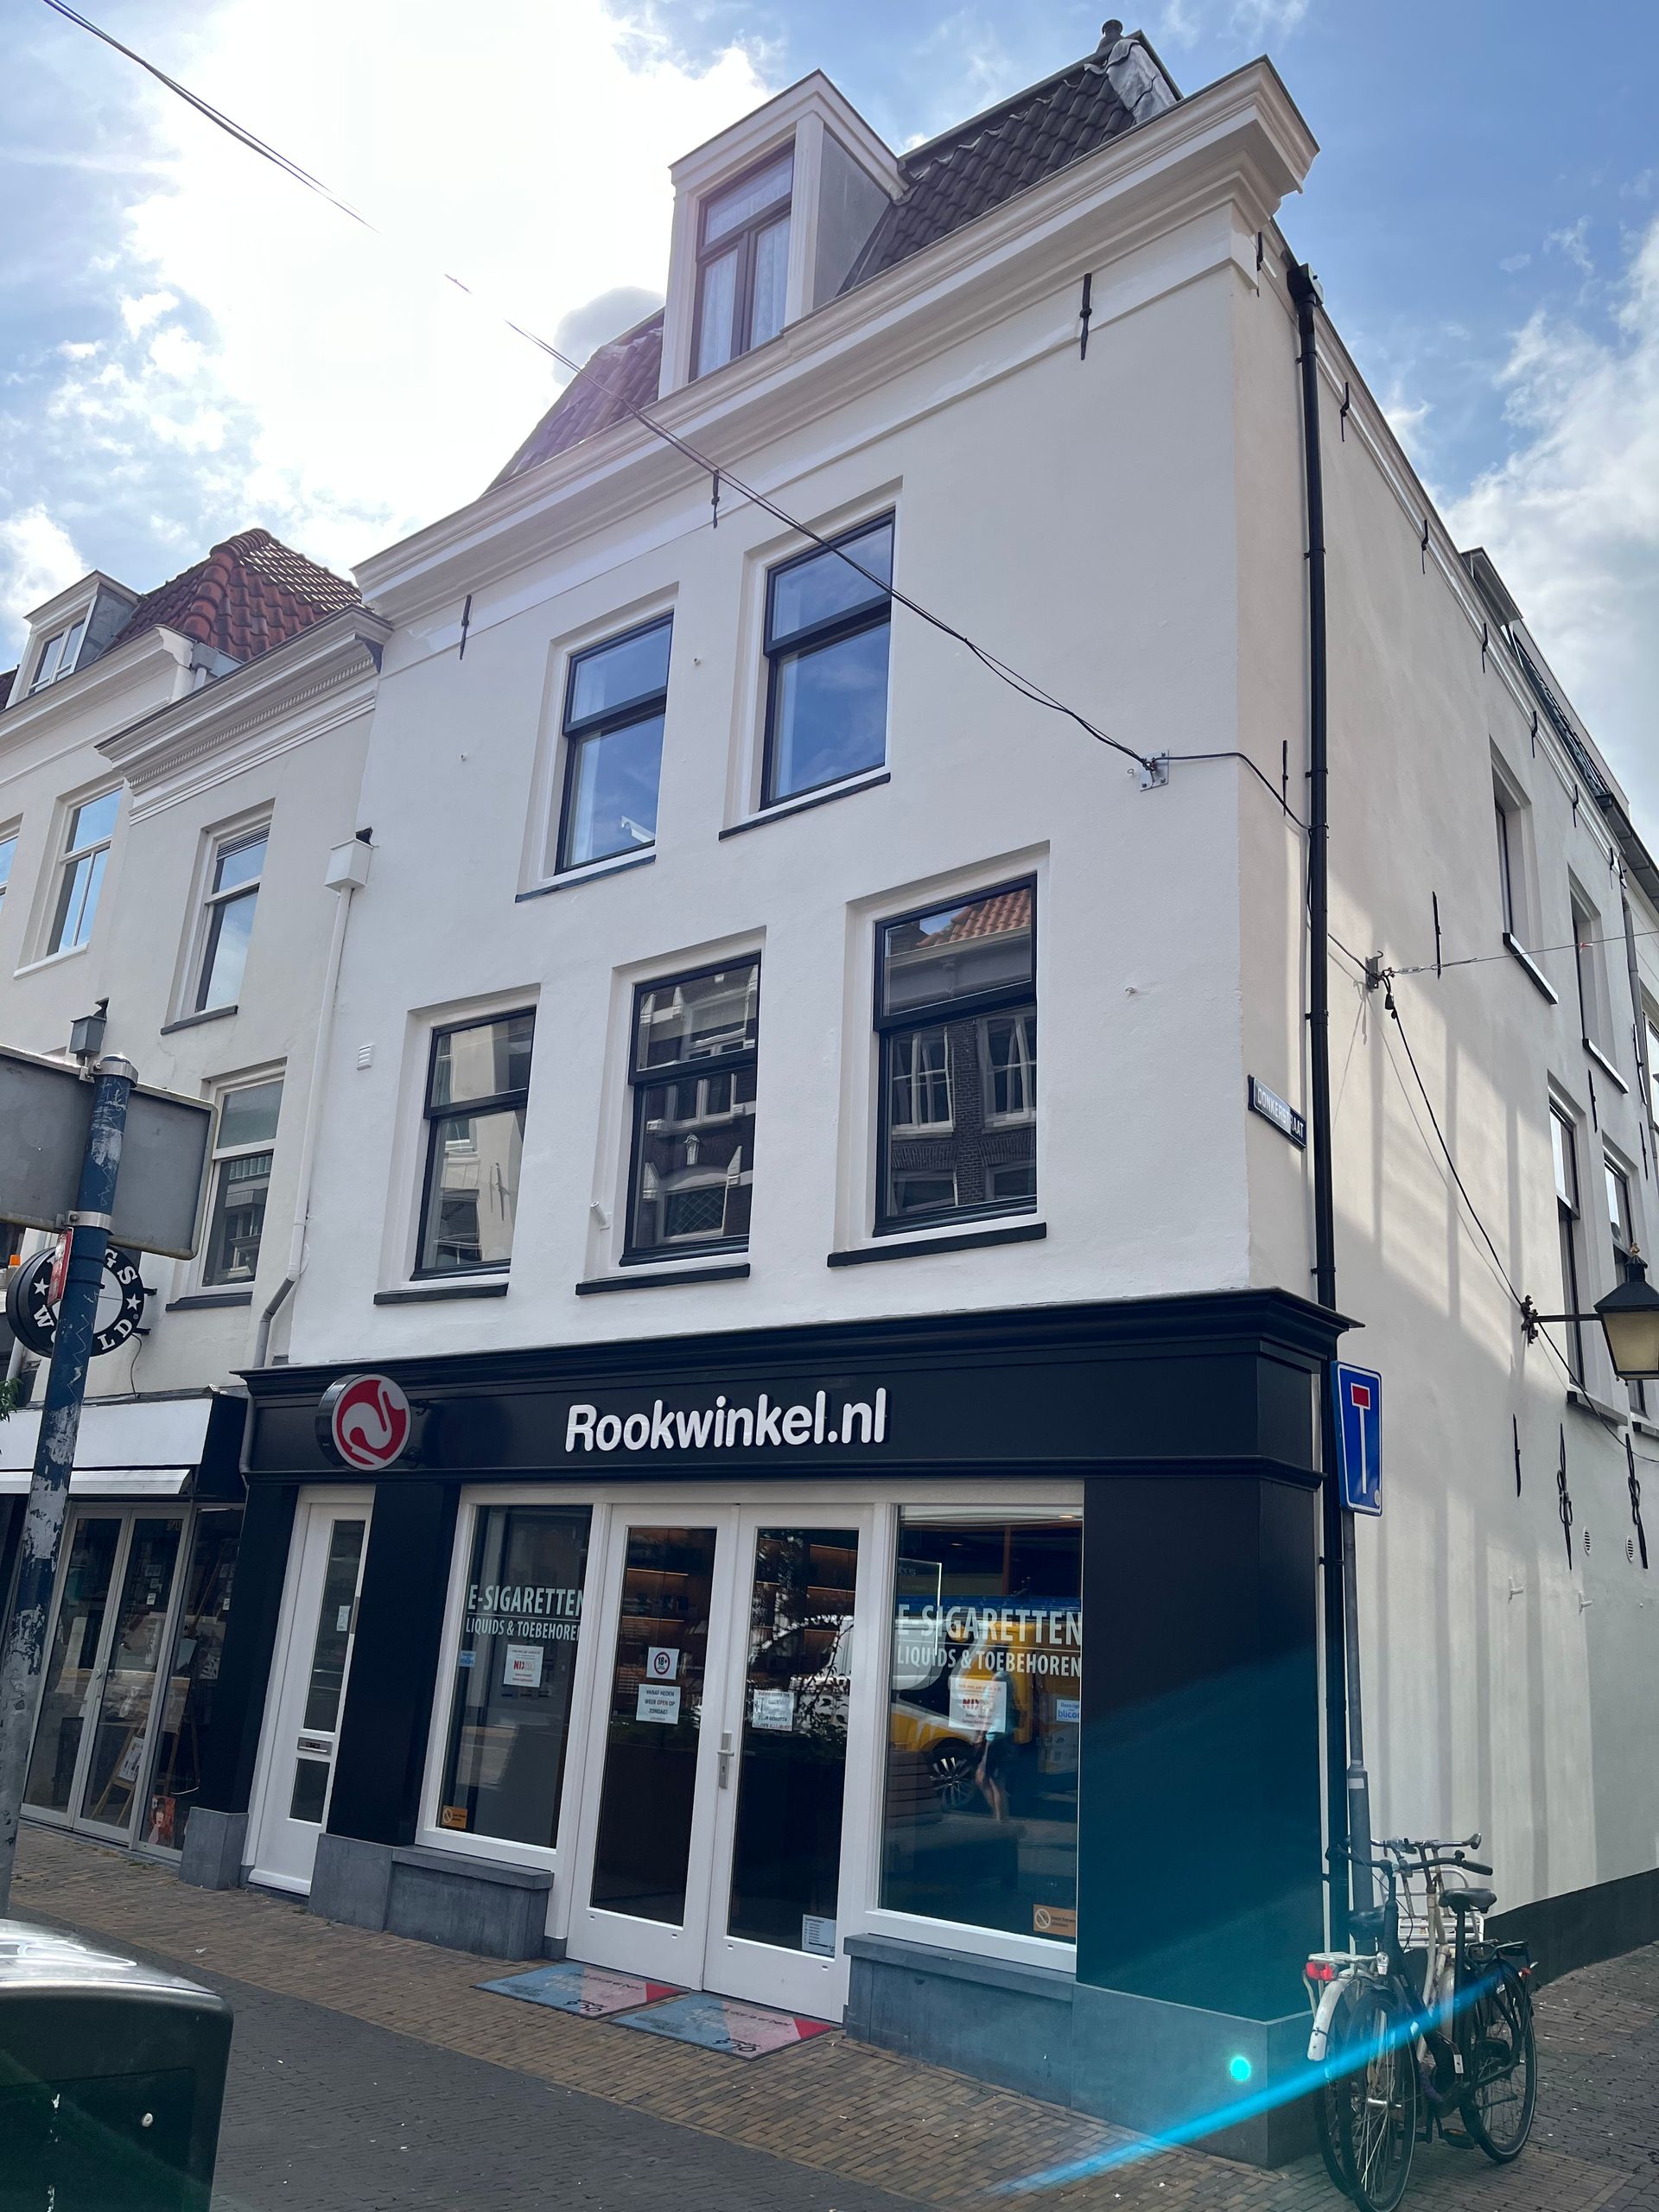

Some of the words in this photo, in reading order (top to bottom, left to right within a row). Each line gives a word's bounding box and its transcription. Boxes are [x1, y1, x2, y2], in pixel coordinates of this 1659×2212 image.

[1257, 1087, 1304, 1139] DONKERSTRAAT
[565, 1387, 887, 1452] Rookwinkel.nl
[465, 1618, 505, 1636] LIQUIDS
[506, 1620, 515, 1637] &
[658, 1656, 668, 1666] 18+
[897, 1645, 957, 1669] LIQUIDS
[960, 1649, 973, 1669] &
[976, 1649, 1081, 1677] TOEBEHOREN
